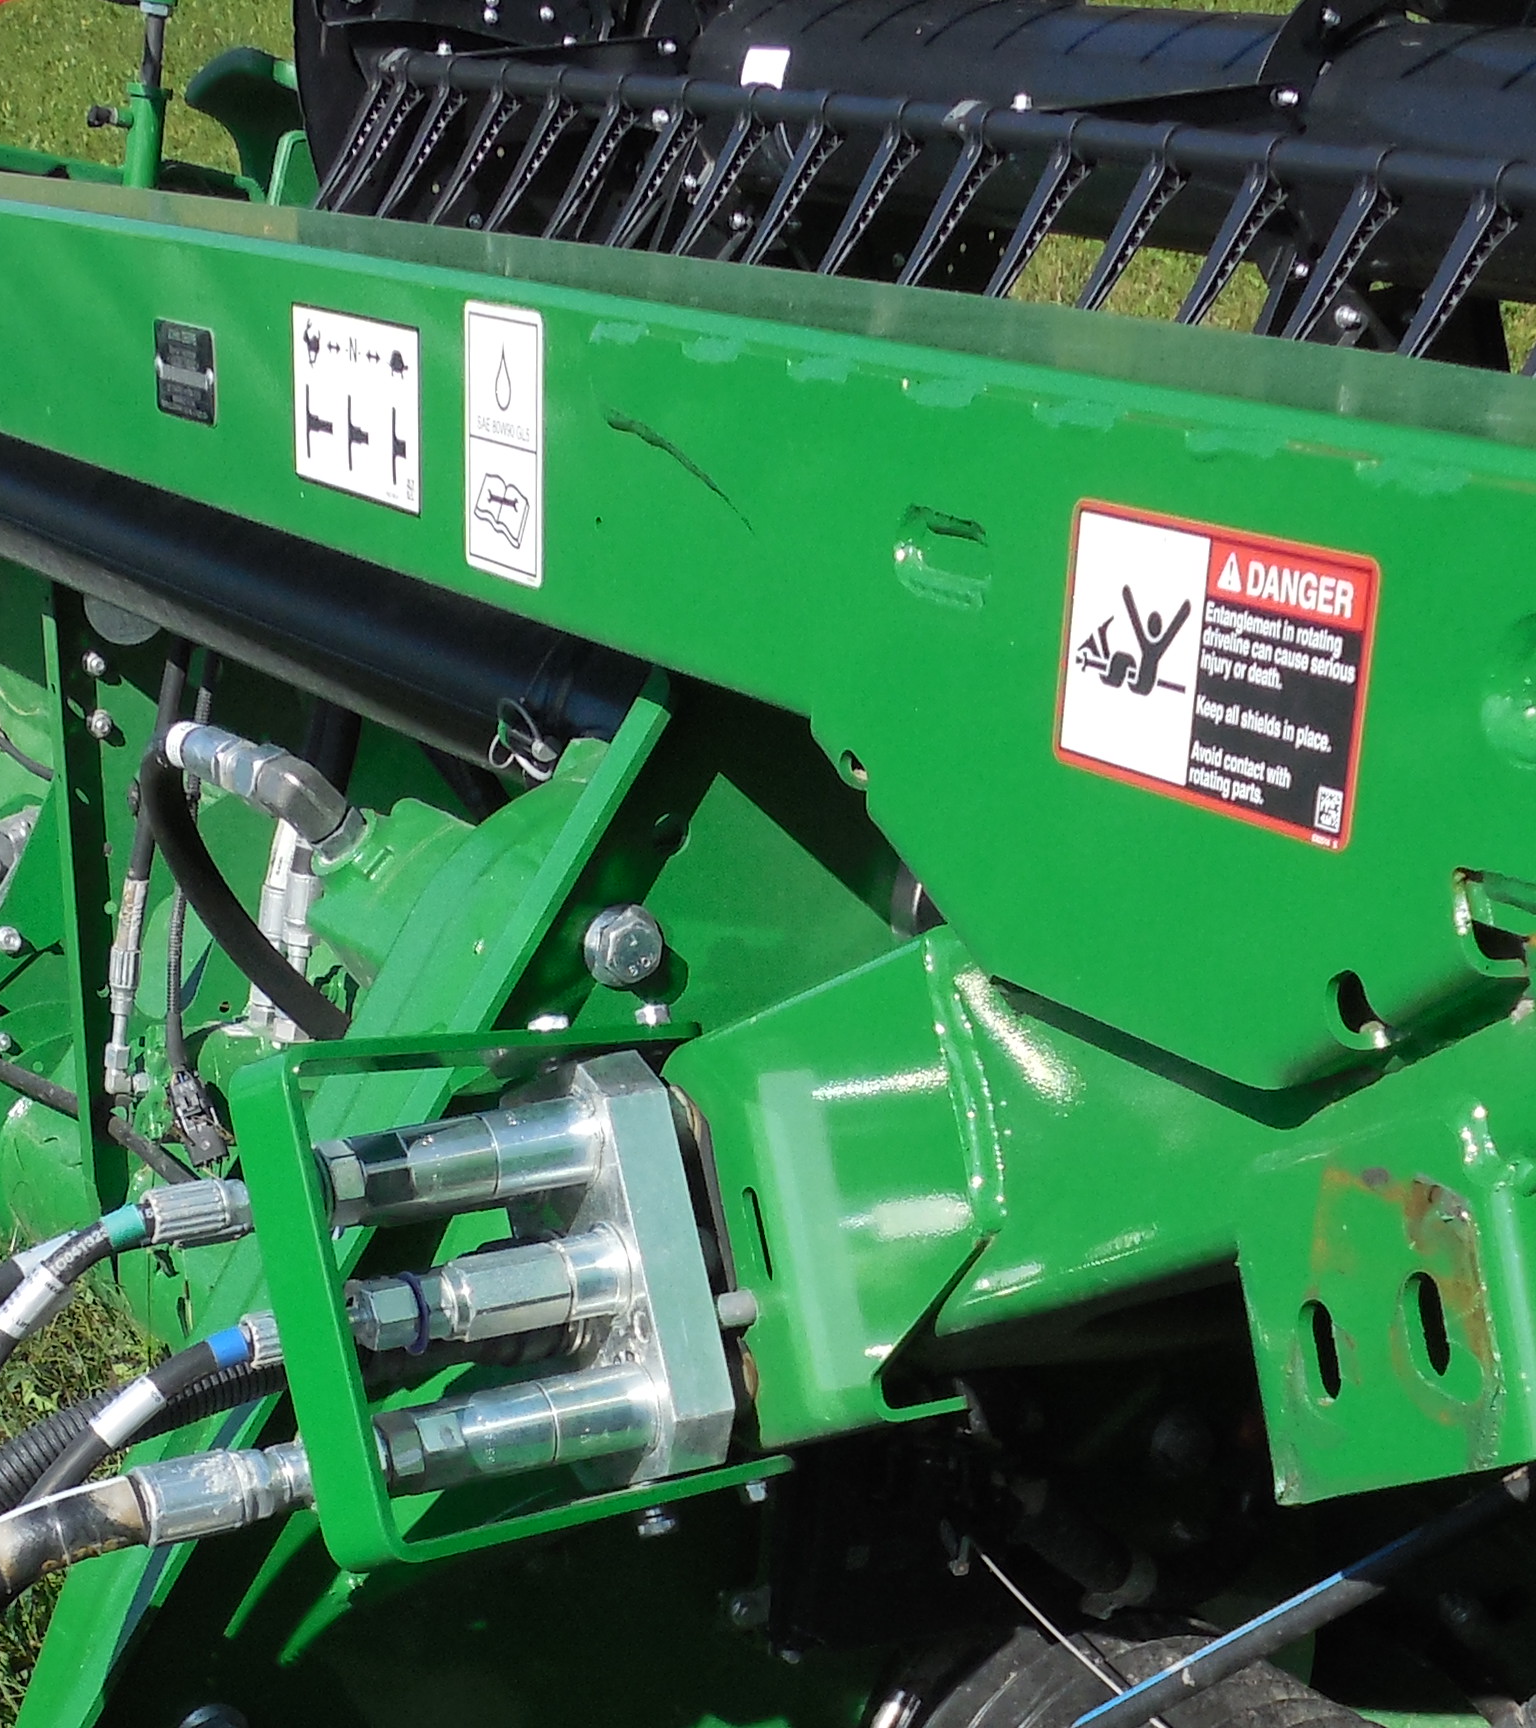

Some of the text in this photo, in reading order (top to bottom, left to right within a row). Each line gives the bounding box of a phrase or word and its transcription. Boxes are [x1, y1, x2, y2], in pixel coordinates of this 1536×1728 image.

[1246, 561, 1354, 618] DANGER
[1202, 626, 1356, 684] driveline can cause serious
[1205, 600, 1343, 658] Entanglement in rotating
[1200, 648, 1283, 691] injury or death.
[1196, 694, 1332, 753] Keep all shields in place.
[1189, 766, 1264, 805] rotating parts.
[1191, 740, 1292, 789] Avoid contact with
